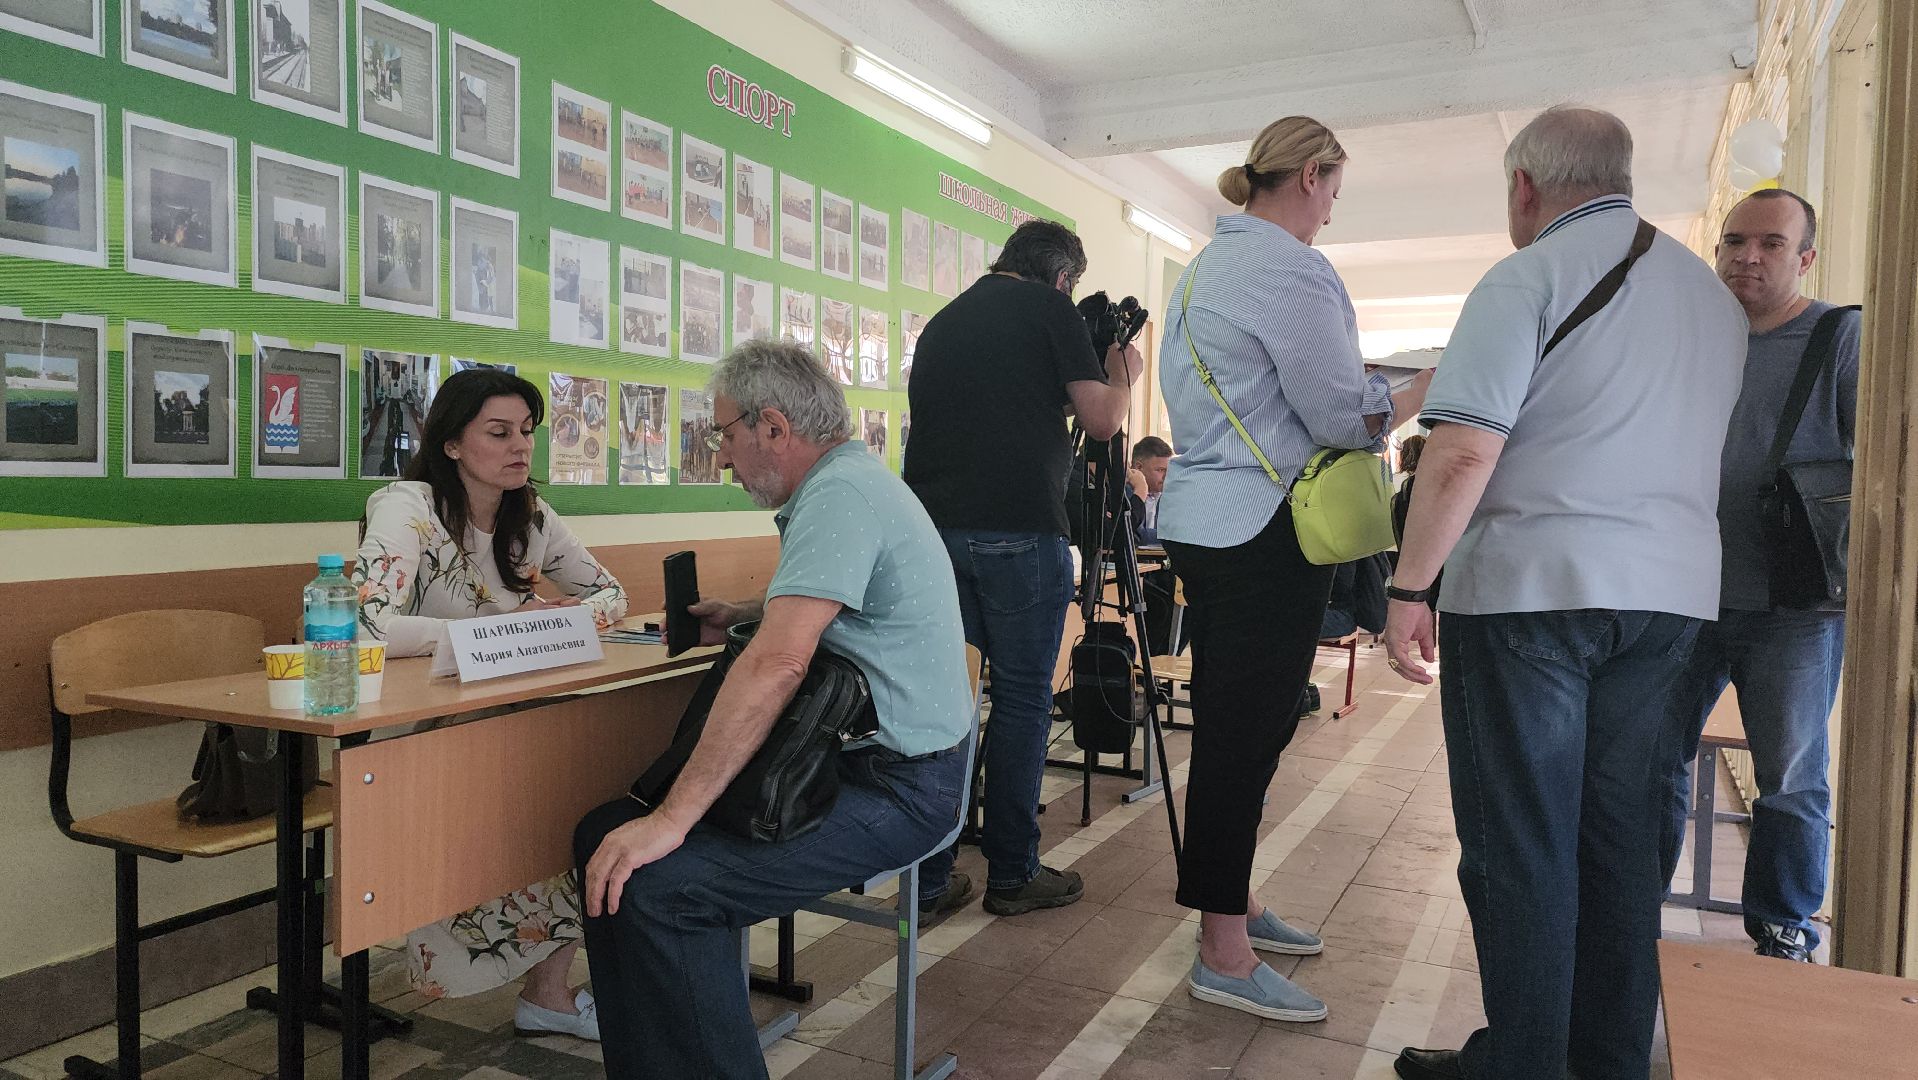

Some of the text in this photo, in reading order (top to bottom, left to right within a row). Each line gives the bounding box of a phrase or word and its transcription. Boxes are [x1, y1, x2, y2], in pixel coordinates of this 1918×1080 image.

[707, 64, 795, 137] СПОРТ
[473, 617, 573, 640] ШАРИБЗЯНОВА
[471, 639, 586, 664] Мария Анатольевна
